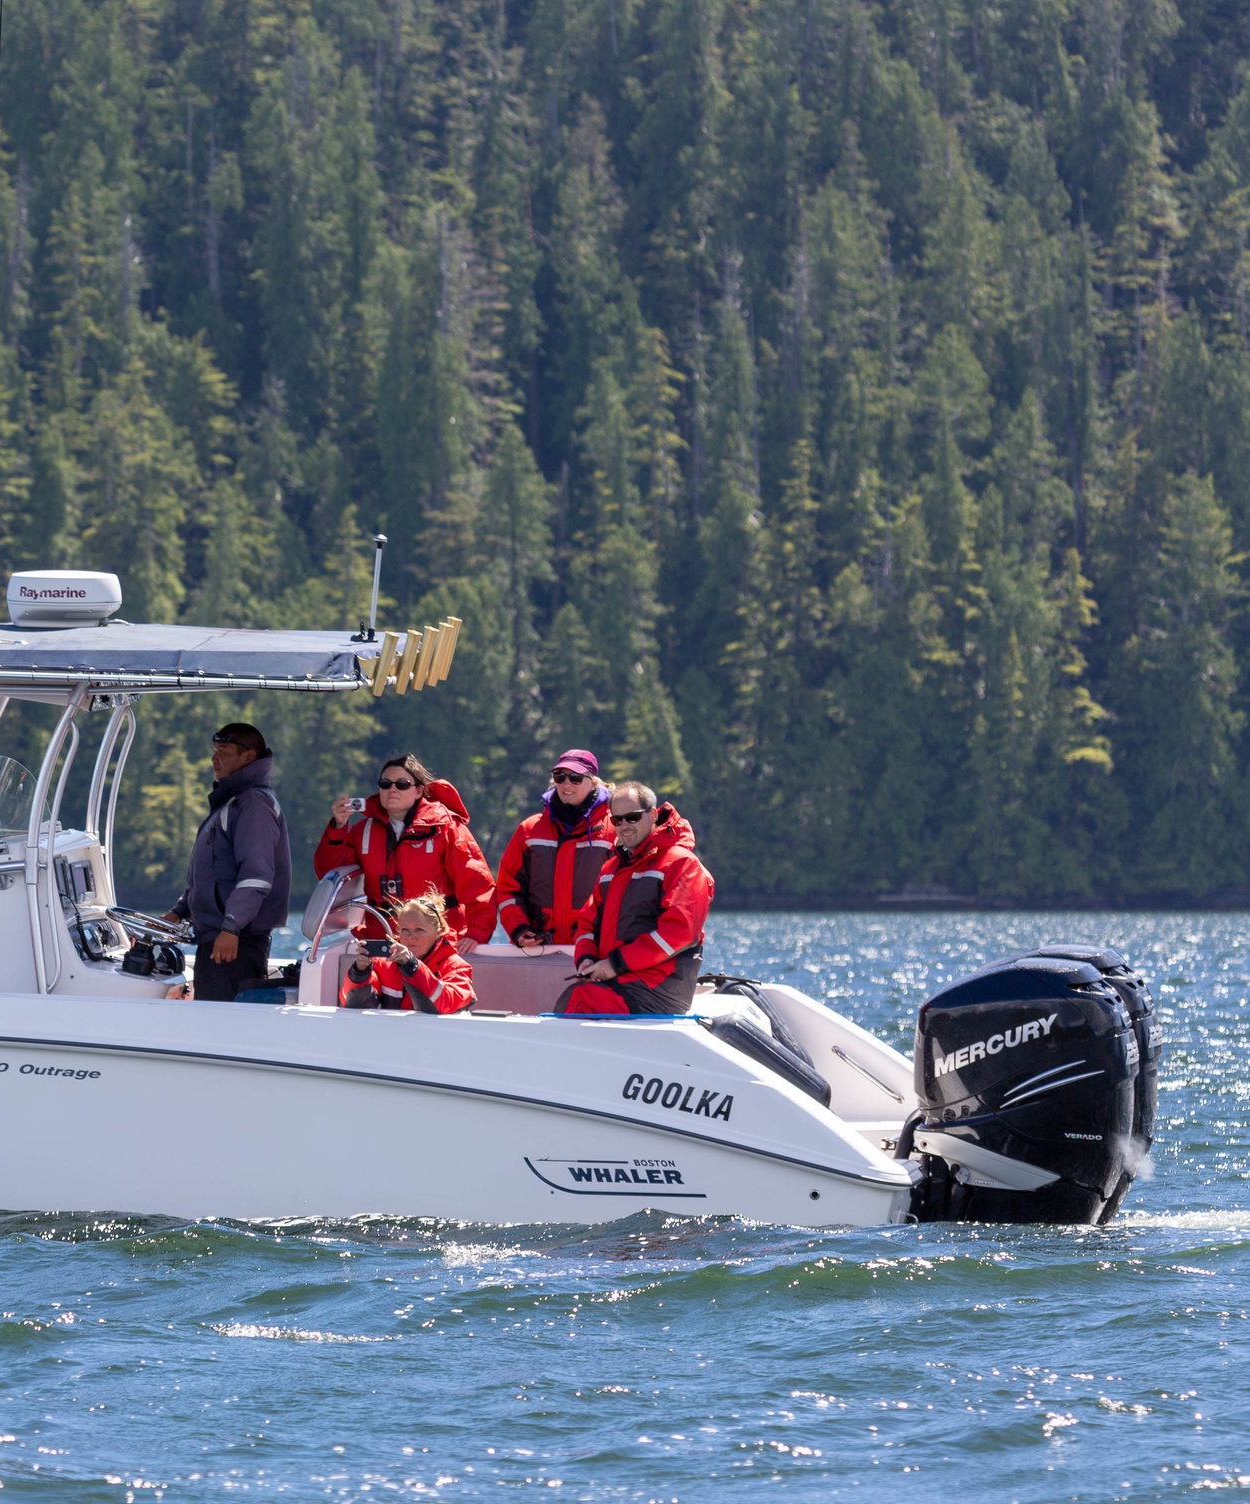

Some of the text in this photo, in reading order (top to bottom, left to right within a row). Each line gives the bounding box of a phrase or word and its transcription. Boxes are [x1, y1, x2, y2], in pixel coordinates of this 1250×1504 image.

[19, 586, 86, 600] Raymarine
[934, 1013, 1058, 1078] MERCURY
[19, 1064, 101, 1080] Outrage
[622, 1073, 734, 1122] GOOLKA
[1064, 1132, 1103, 1141] VERADO
[634, 1159, 676, 1168] BOSTON
[567, 1167, 685, 1185] WHALER
